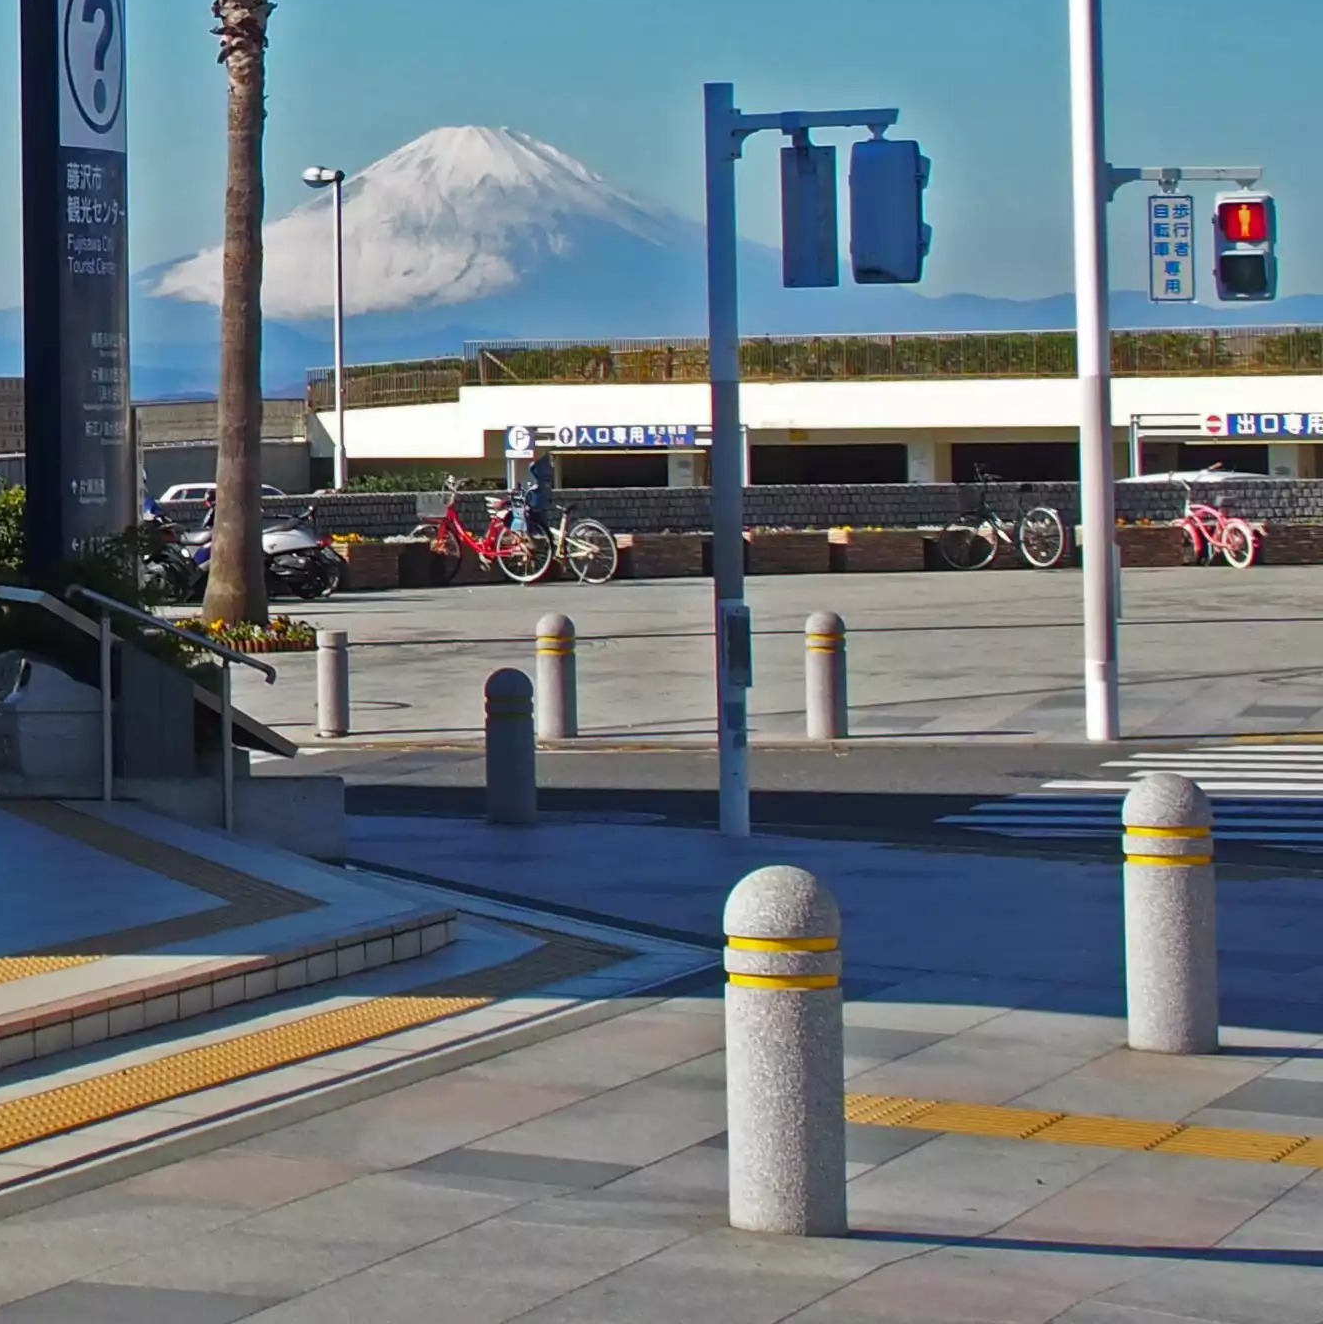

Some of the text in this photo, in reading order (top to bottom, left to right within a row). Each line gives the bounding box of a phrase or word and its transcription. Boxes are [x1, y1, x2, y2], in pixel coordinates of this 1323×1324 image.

[66, 162, 103, 191] 藤沢市
[66, 195, 126, 226] 観光センター
[1153, 204, 1170, 257] 自転車
[1172, 204, 1190, 257] 歩行者
[1165, 261, 1181, 295] 専用
[577, 427, 646, 445] 入口専用
